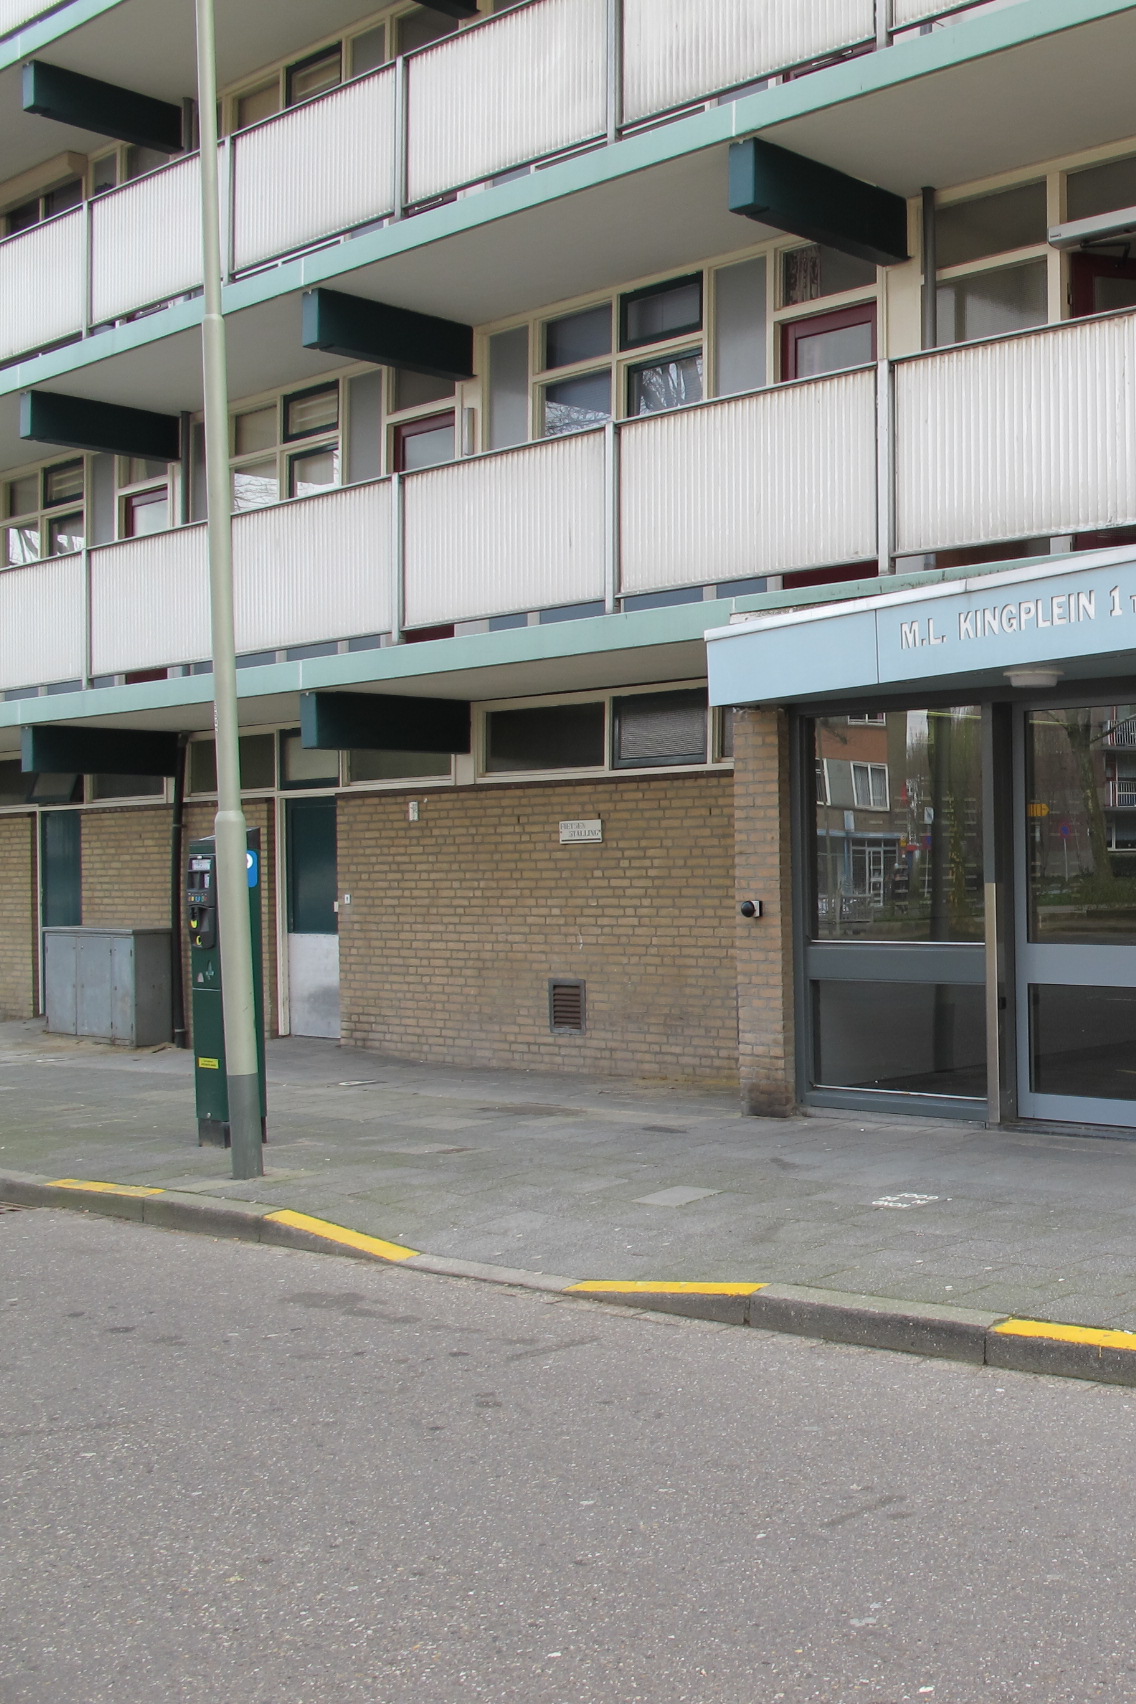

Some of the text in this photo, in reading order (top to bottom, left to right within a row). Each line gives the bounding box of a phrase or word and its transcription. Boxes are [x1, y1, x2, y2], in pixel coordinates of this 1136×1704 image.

[901, 618, 946, 649] M.L.
[958, 589, 1096, 641] KINGPLEIN
[1109, 585, 1123, 617] 1
